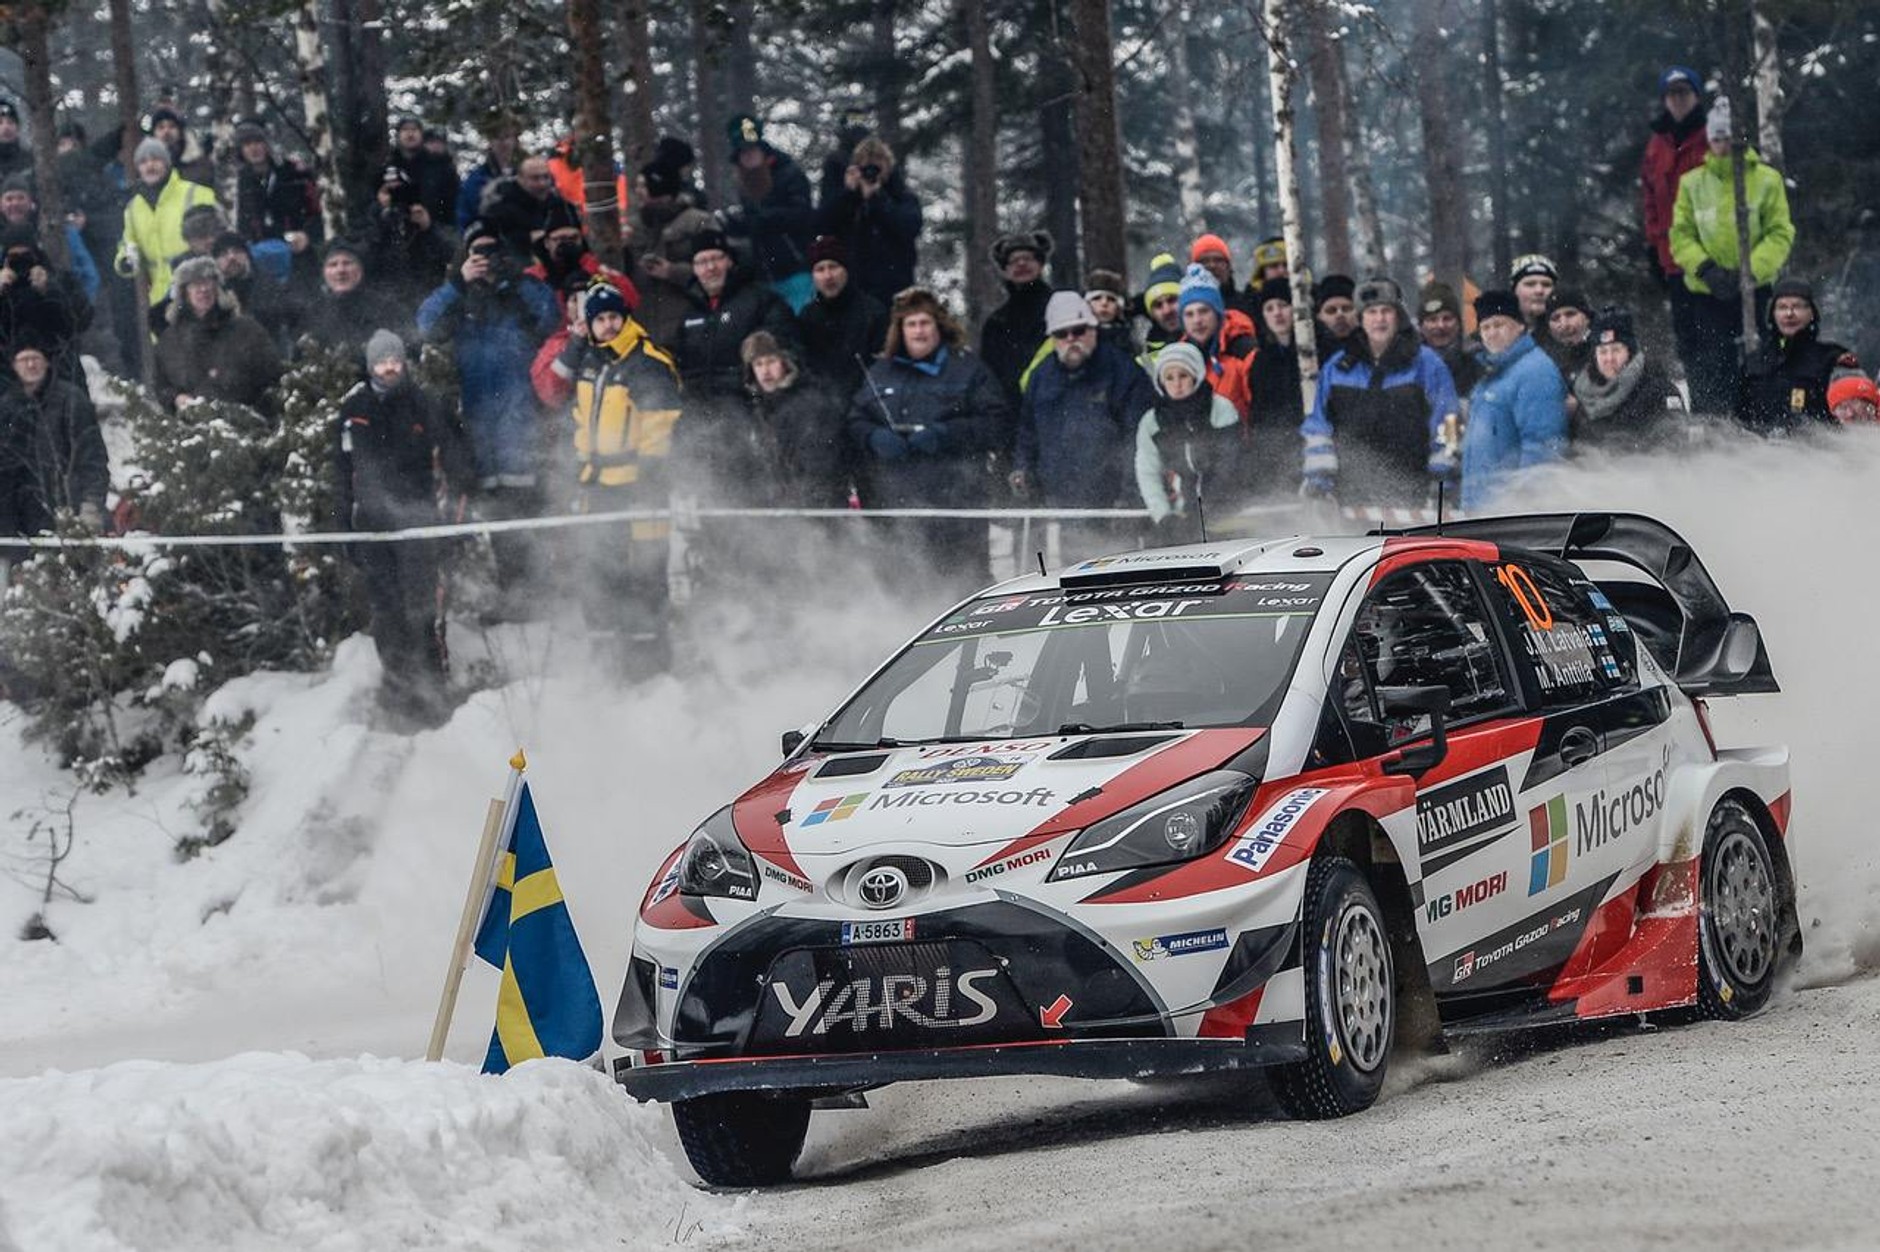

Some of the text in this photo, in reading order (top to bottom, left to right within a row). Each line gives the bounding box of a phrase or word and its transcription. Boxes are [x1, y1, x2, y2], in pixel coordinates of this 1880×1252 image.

[1118, 551, 1220, 564] Microsoft
[1029, 589, 1124, 607] TOYOTA
[1128, 583, 1222, 597] GAZOO
[1223, 580, 1312, 593] Racing
[1257, 597, 1320, 607] Lexar
[1497, 563, 1553, 632] 10
[1037, 598, 1204, 627] Lexar
[934, 620, 995, 634] Lexar
[1535, 659, 1595, 690] M. Anttila
[920, 741, 1052, 760] DENSO
[894, 769, 944, 783] RALLY
[946, 763, 1021, 778] SWEDEN
[868, 787, 1056, 811] Microsoft
[1232, 788, 1324, 866] Panasonic
[1417, 783, 1511, 845] VÄRMLAND
[964, 848, 1053, 884] DMG MORI
[1057, 861, 1099, 878] PIAA
[728, 885, 753, 898] PIAA
[764, 866, 814, 894] DMG MORI
[1425, 871, 1508, 924] MG MORI
[1168, 932, 1226, 950] MICHELIN
[1452, 907, 1581, 985] GR TOYOTA GAZOO Racing
